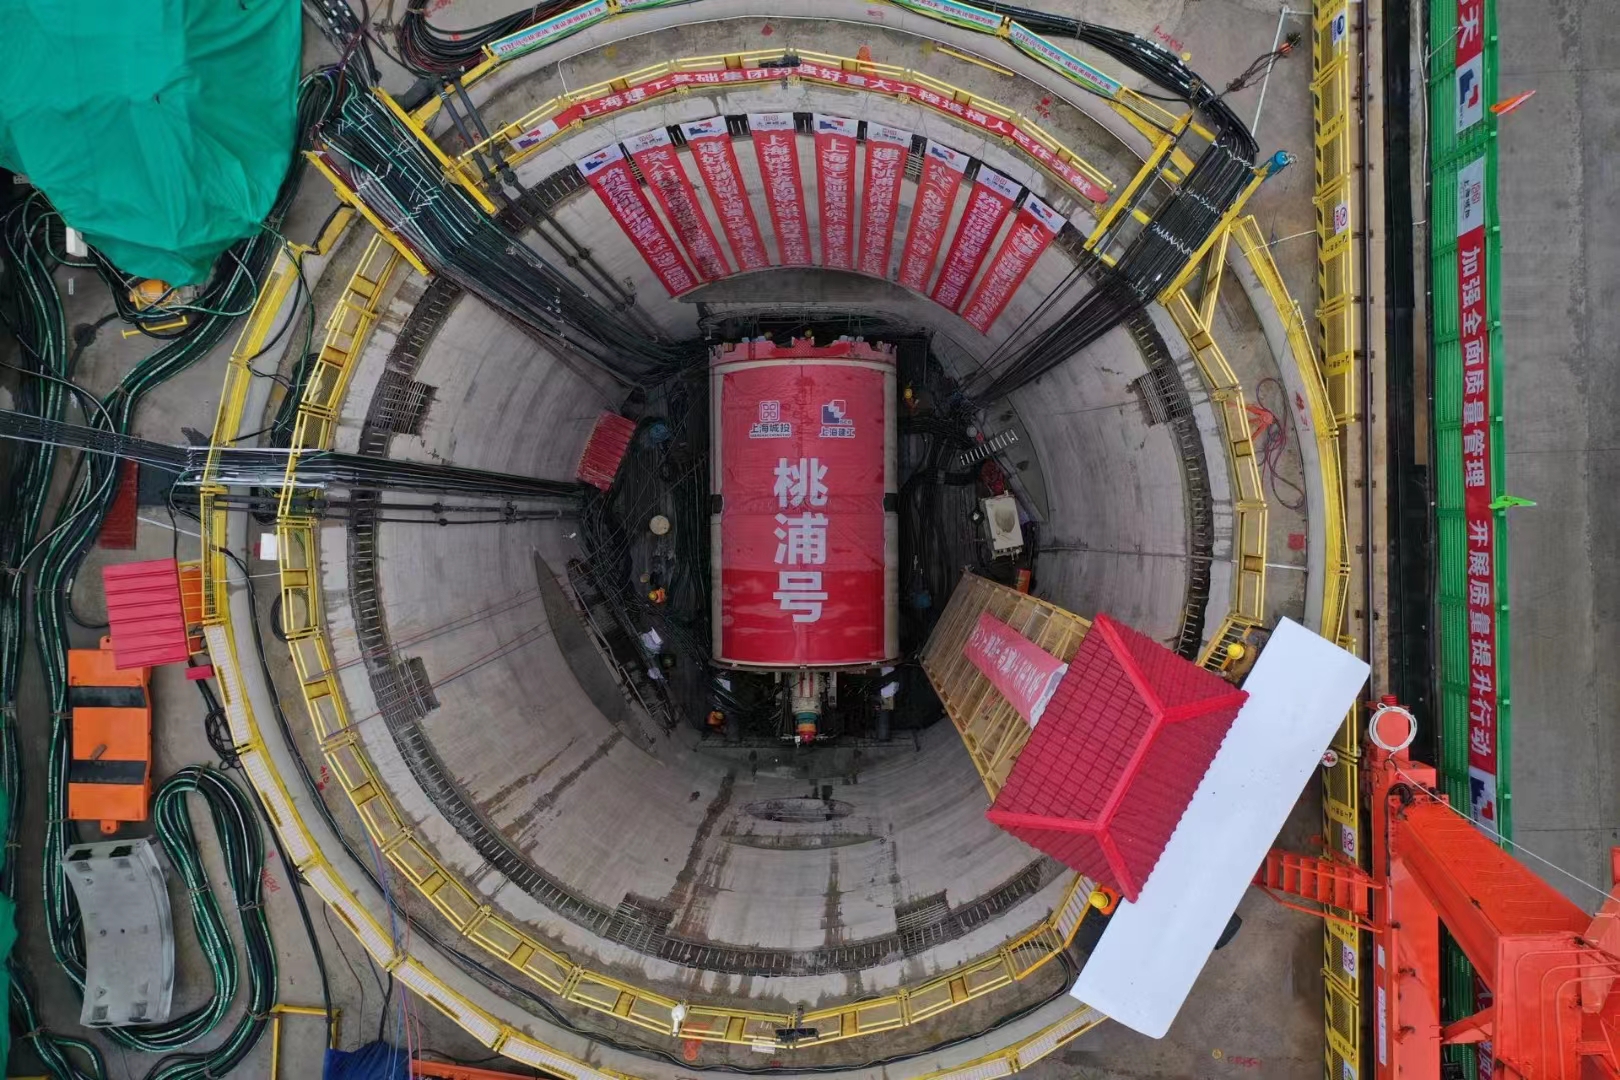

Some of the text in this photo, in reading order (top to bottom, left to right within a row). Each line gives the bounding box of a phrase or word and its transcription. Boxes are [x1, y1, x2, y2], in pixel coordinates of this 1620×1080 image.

[1459, 0, 1479, 48] 天
[750, 423, 790, 434] 上海城投
[820, 428, 855, 437] 上海建工
[1461, 246, 1492, 757] 加强全面质量管理 开展质量提升行动
[772, 457, 829, 623] 桃浦号
